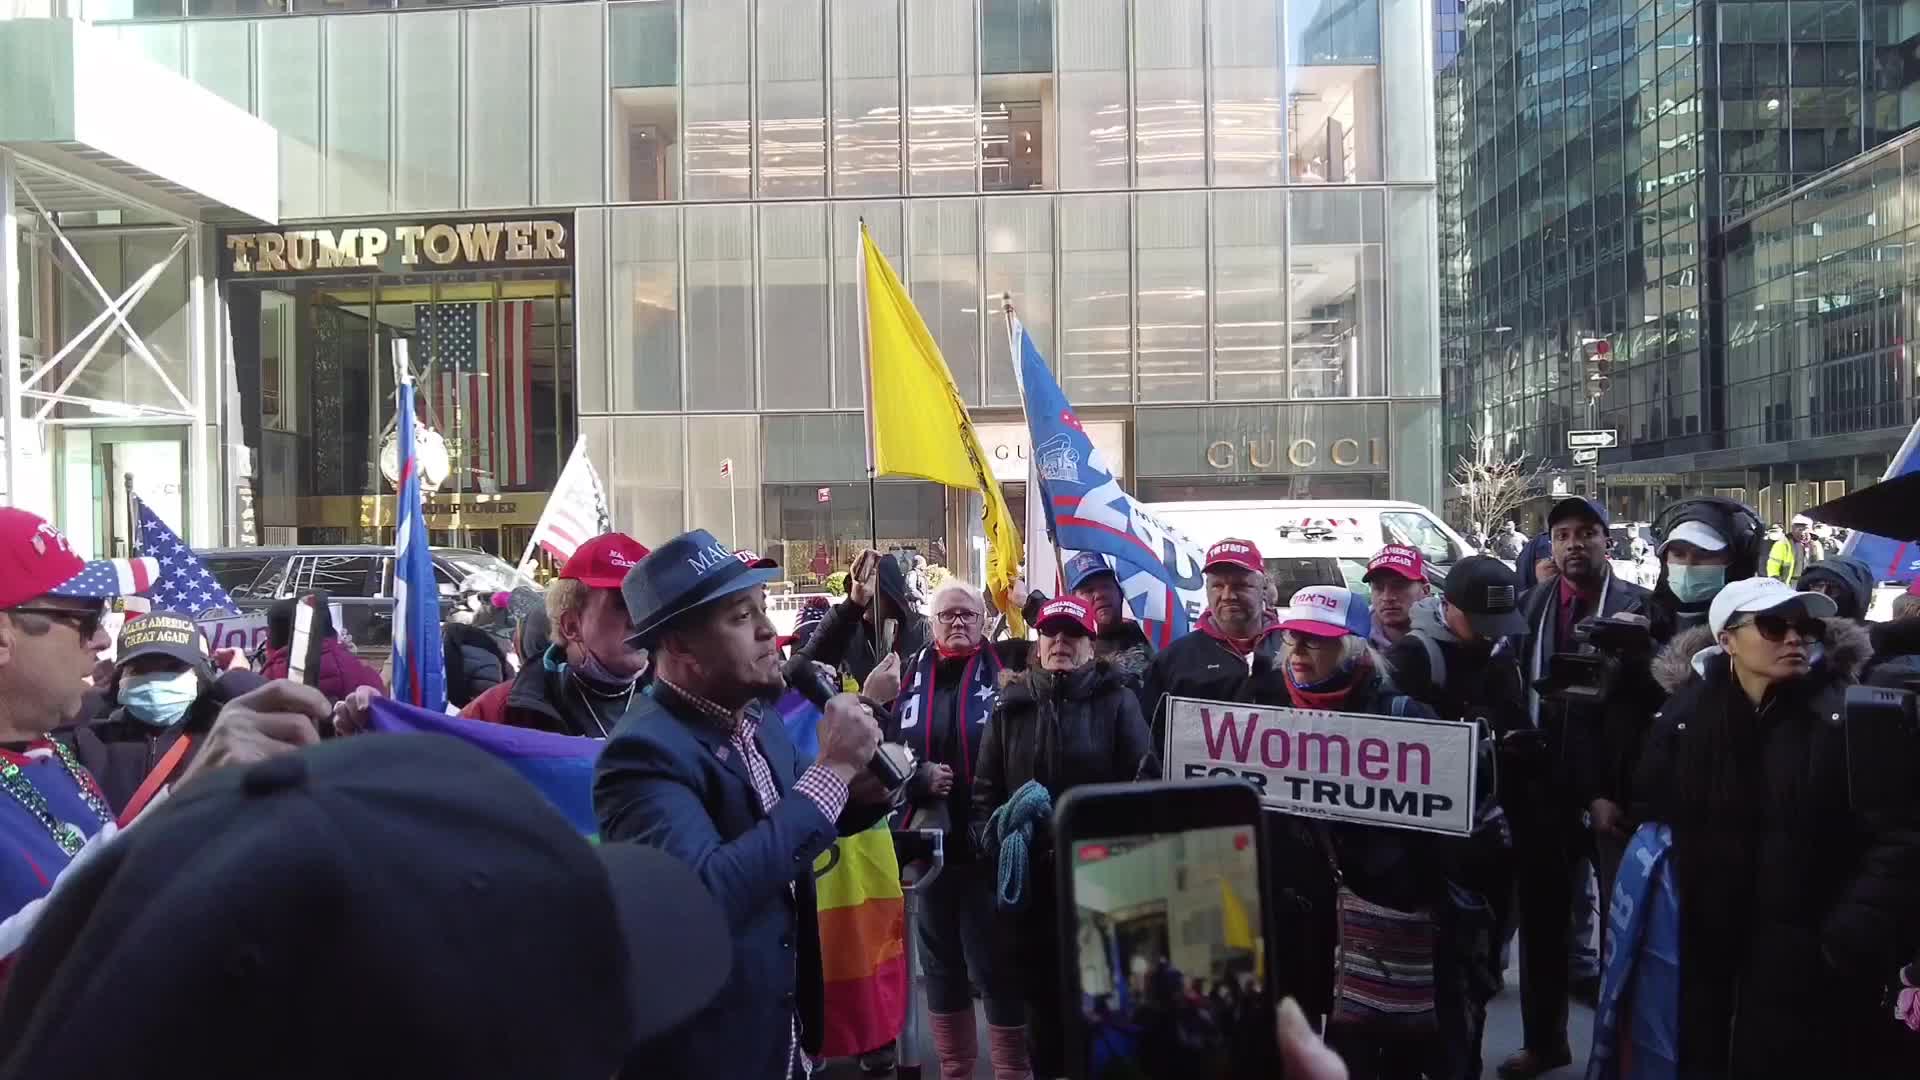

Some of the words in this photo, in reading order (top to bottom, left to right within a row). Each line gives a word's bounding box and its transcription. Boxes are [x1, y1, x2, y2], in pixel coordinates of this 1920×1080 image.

[227, 227, 388, 273] TRUMP
[395, 220, 566, 265] TOWER
[995, 444, 1028, 460] GU
[1207, 438, 1384, 468] GUCCI
[464, 502, 517, 514] TOWER
[1209, 543, 1249, 558] TRUMP
[1388, 555, 1412, 567] AGAIN
[148, 616, 195, 632] AMERICA
[124, 630, 157, 649] GREAT
[158, 631, 190, 645] AGAIN
[1200, 708, 1431, 785] Women
[1284, 776, 1453, 818] TRUMP
